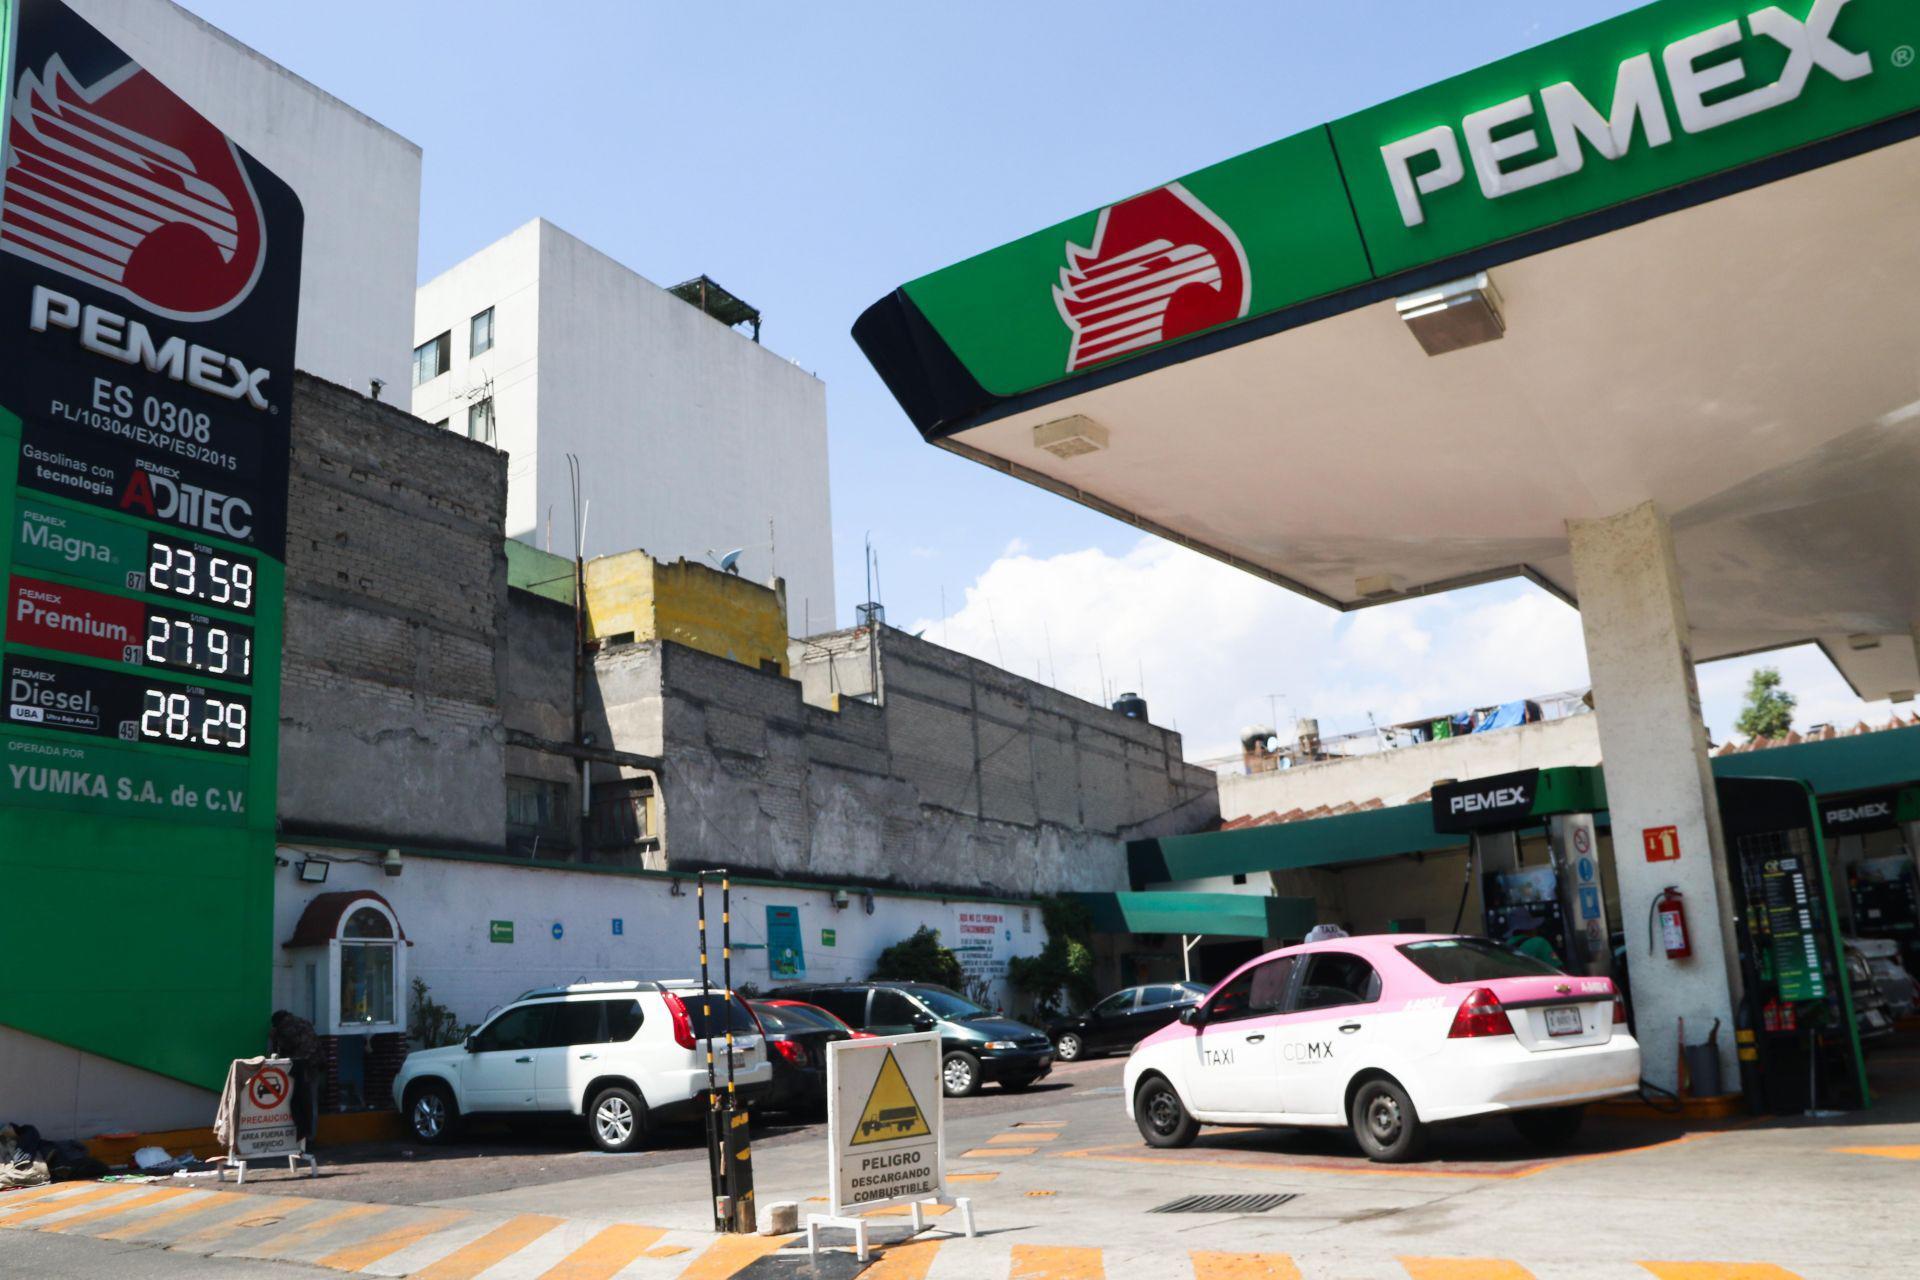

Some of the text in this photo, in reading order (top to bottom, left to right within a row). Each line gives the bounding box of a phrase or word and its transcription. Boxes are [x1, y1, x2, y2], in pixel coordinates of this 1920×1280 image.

[1379, 0, 1873, 228] PEMEX
[29, 284, 271, 411] PEMEX
[93, 377, 211, 445] ES 0308
[51, 400, 238, 471] PL/10304/EXP/ES/2015
[23, 444, 115, 480] Gasolinas con
[135, 458, 181, 480] PEMEX
[36, 464, 114, 497] tecnología
[24, 510, 66, 528] PEMEX
[21, 520, 111, 563] Magna
[127, 572, 142, 588] 87
[149, 542, 253, 609] 23.59
[19, 587, 62, 605] PEMEX
[16, 599, 128, 642] Premium
[124, 646, 140, 663] 91
[147, 615, 250, 676] 27.91
[12, 667, 56, 683] PEMEX
[10, 679, 92, 713] Diesel
[16, 708, 38, 719] UBA
[141, 689, 247, 749] 28.29
[119, 722, 135, 740] 45
[8, 741, 84, 759] OPERADA POR
[9, 763, 245, 813] YUMKA S.A. de C.V.
[1450, 785, 1526, 815] PEMEX
[1826, 802, 1889, 825] PEMEX
[1205, 1047, 1235, 1067] TAXI
[1283, 1041, 1334, 1061] CDMX
[862, 1151, 921, 1171] PELIGRO
[851, 1166, 930, 1189] DESCARGANDO
[854, 1181, 929, 1202] COMBUSTIBLE
